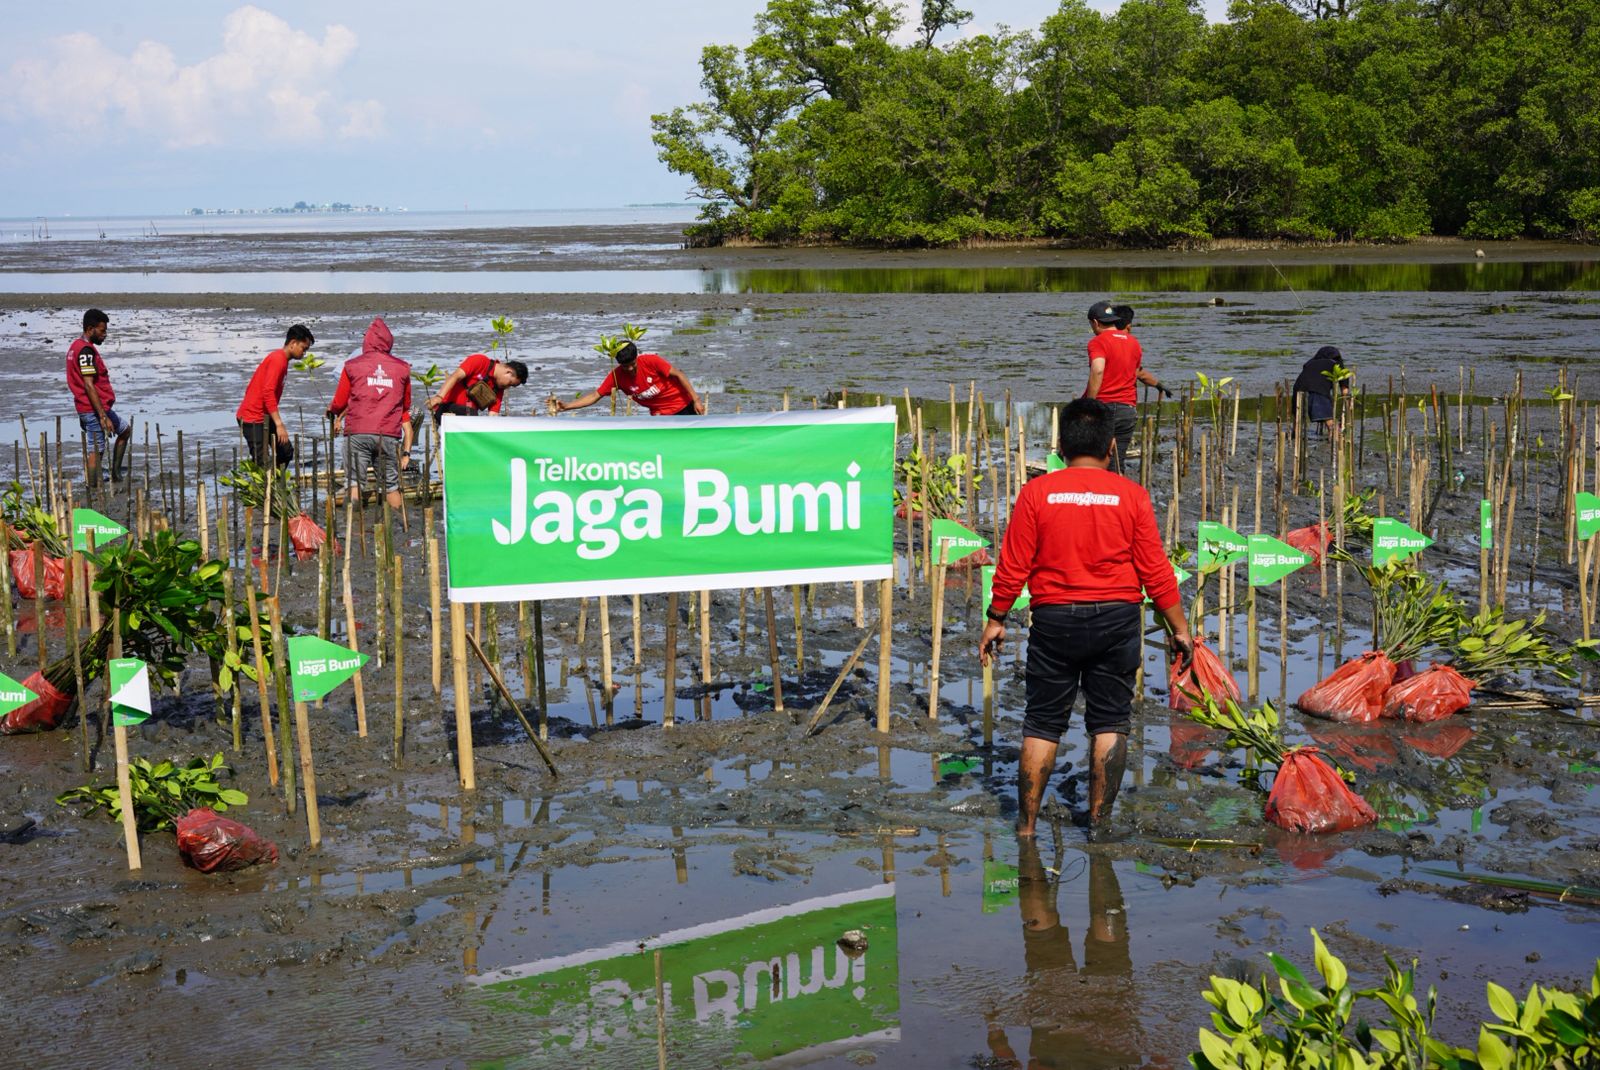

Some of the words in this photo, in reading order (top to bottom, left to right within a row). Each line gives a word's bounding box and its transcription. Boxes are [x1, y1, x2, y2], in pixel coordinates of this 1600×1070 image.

[79, 354, 94, 367] 27
[535, 454, 664, 482] Telkomsel
[1047, 492, 1120, 506] COMMANDER
[491, 457, 663, 560] Jaga
[682, 460, 861, 538] Bumi
[98, 525, 122, 535] Bumi
[957, 537, 983, 548] Bumi
[1226, 541, 1248, 553] Bum
[1377, 536, 1399, 550] Jaga
[1399, 537, 1426, 548] Bumi
[1252, 553, 1277, 567] Jaga
[1277, 554, 1305, 565] Bumi
[296, 660, 327, 677] Jaga
[328, 655, 361, 672] Bumi
[0, 689, 27, 703] umi
